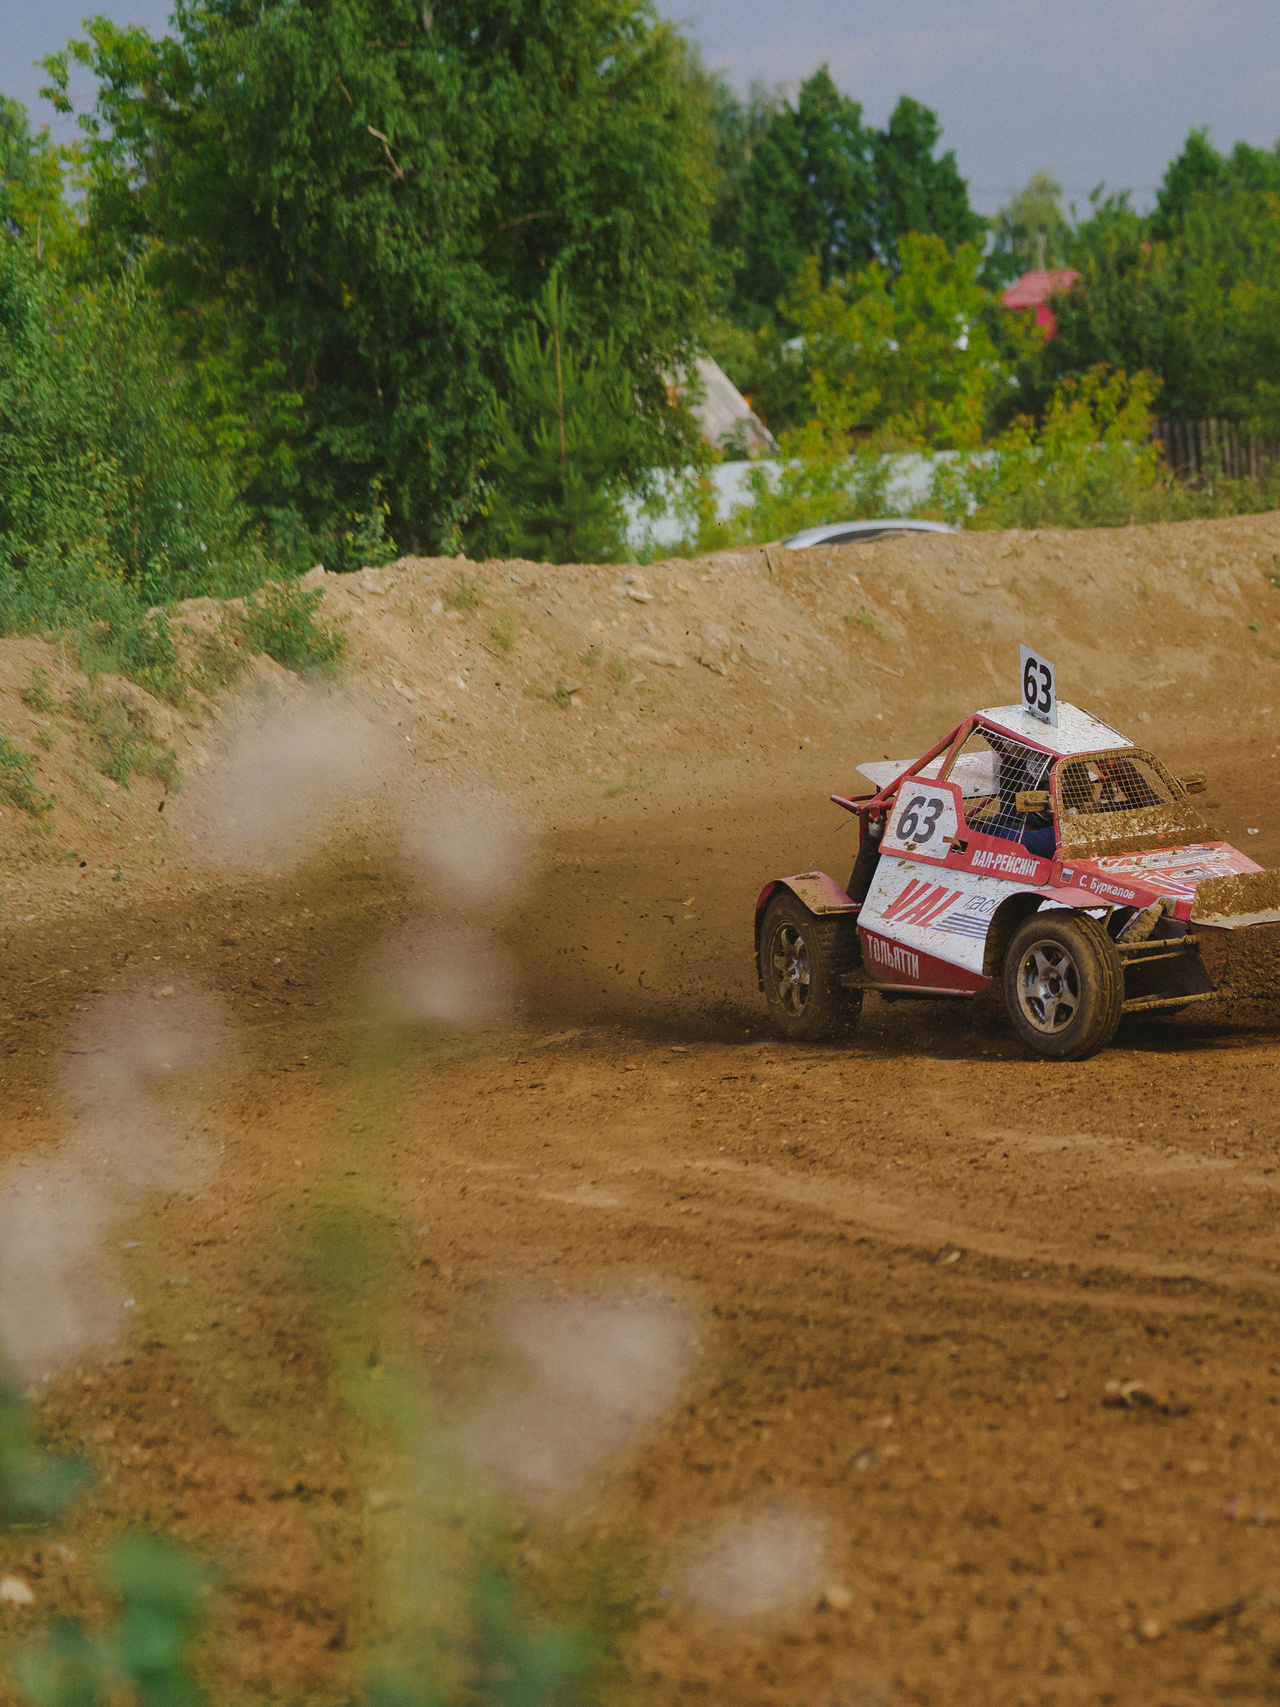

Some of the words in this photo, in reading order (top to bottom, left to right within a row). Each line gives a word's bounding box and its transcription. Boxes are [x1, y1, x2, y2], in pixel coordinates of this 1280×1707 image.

[1024, 657, 1052, 714] 63
[896, 796, 945, 844] 63
[971, 849, 1041, 877] ВАЛ-РЕЙСИНГ
[879, 878, 965, 928] VAL
[962, 894, 1006, 915] raci
[1079, 874, 1088, 888] С.
[1089, 877, 1136, 900] Буркалов
[866, 934, 920, 980] ТОЛЬЯТТИ
